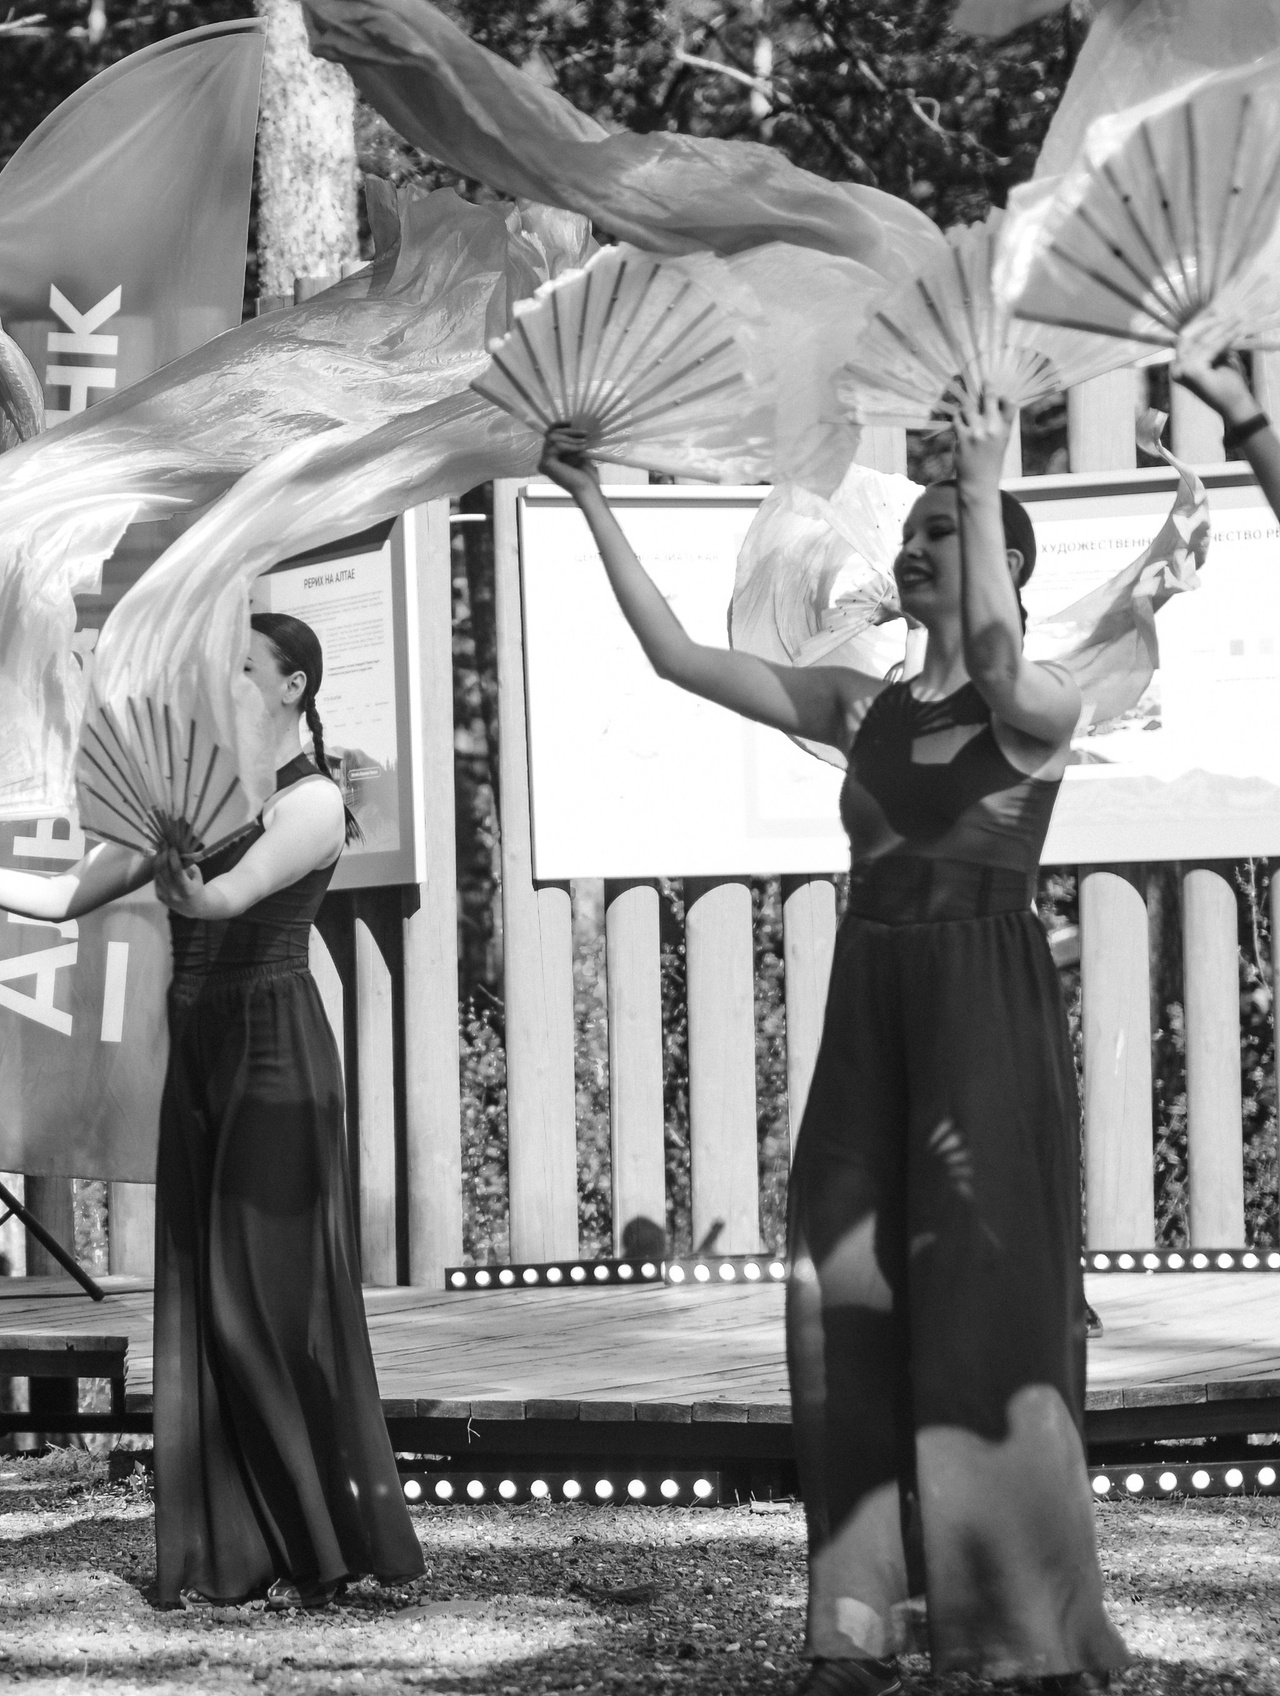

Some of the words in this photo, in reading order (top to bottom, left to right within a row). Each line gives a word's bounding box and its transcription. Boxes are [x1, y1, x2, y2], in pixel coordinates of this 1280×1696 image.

[303, 577, 324, 590] РЕРИХ
[325, 573, 334, 584] НА
[335, 568, 356, 583] АЛТАЕ
